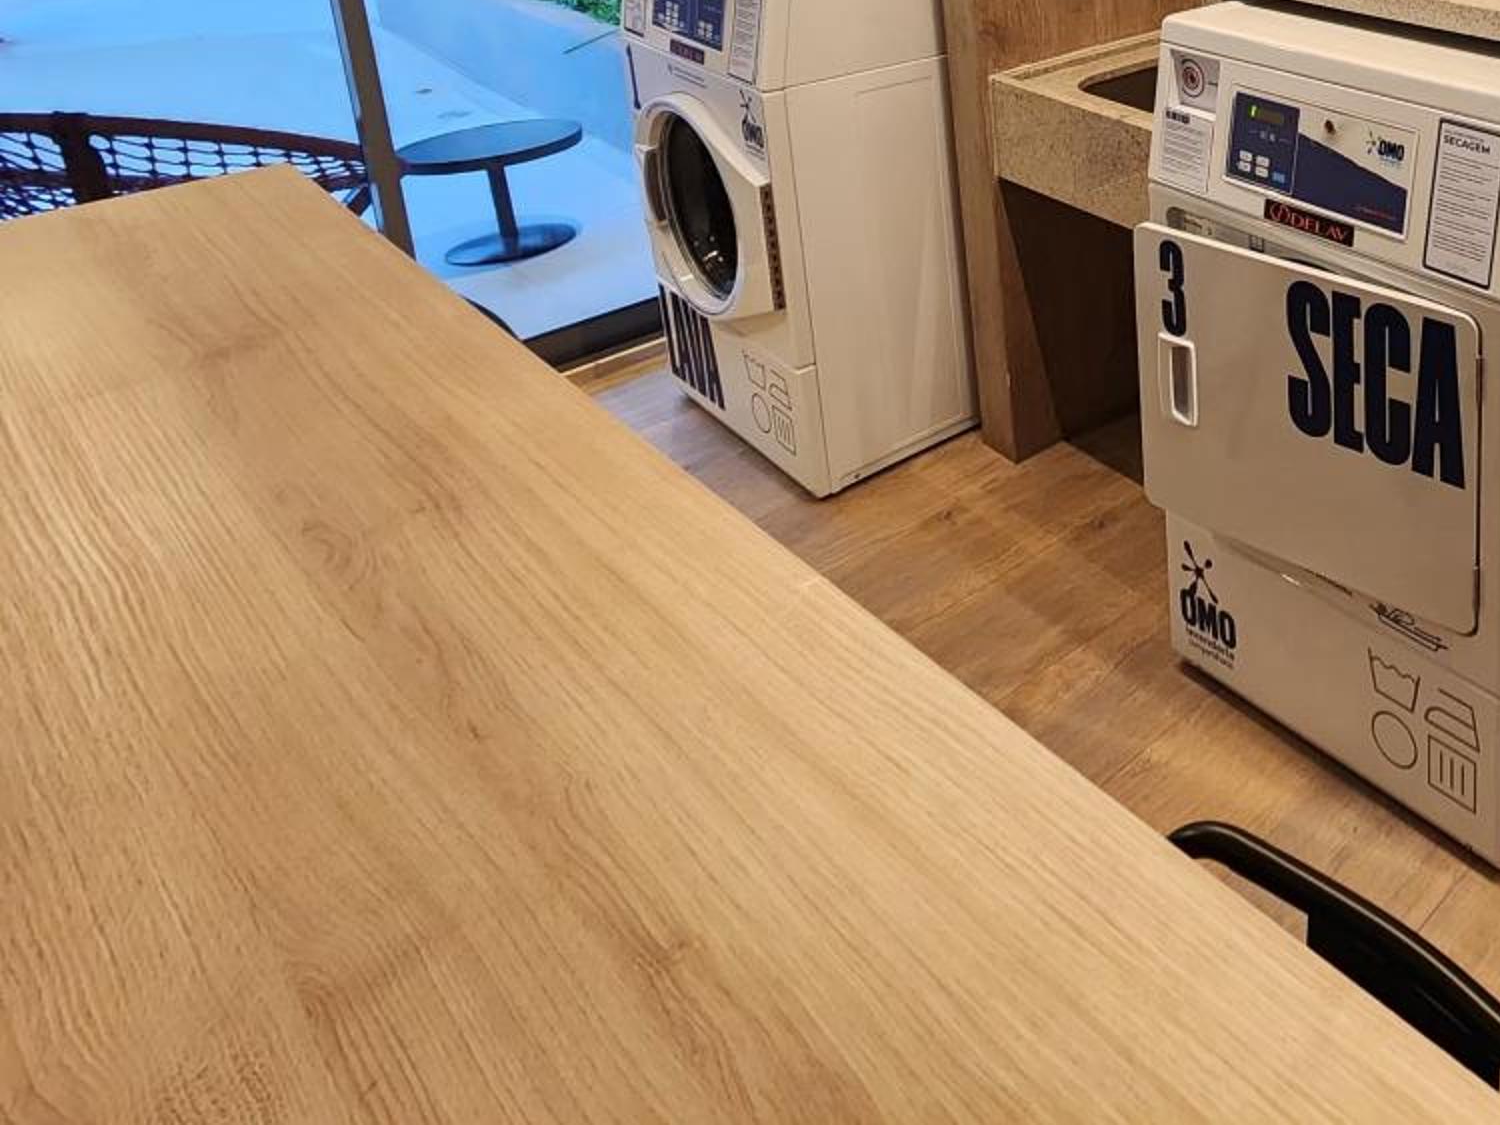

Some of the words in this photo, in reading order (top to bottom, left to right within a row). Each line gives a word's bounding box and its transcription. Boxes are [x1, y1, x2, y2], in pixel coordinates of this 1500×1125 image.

[1378, 139, 1405, 161] OMO
[1443, 134, 1491, 155] SECAGEM
[1159, 239, 1187, 338] 3
[657, 282, 726, 411] LAVA
[1286, 280, 1466, 490] SECA
[1180, 587, 1237, 649] OMO
